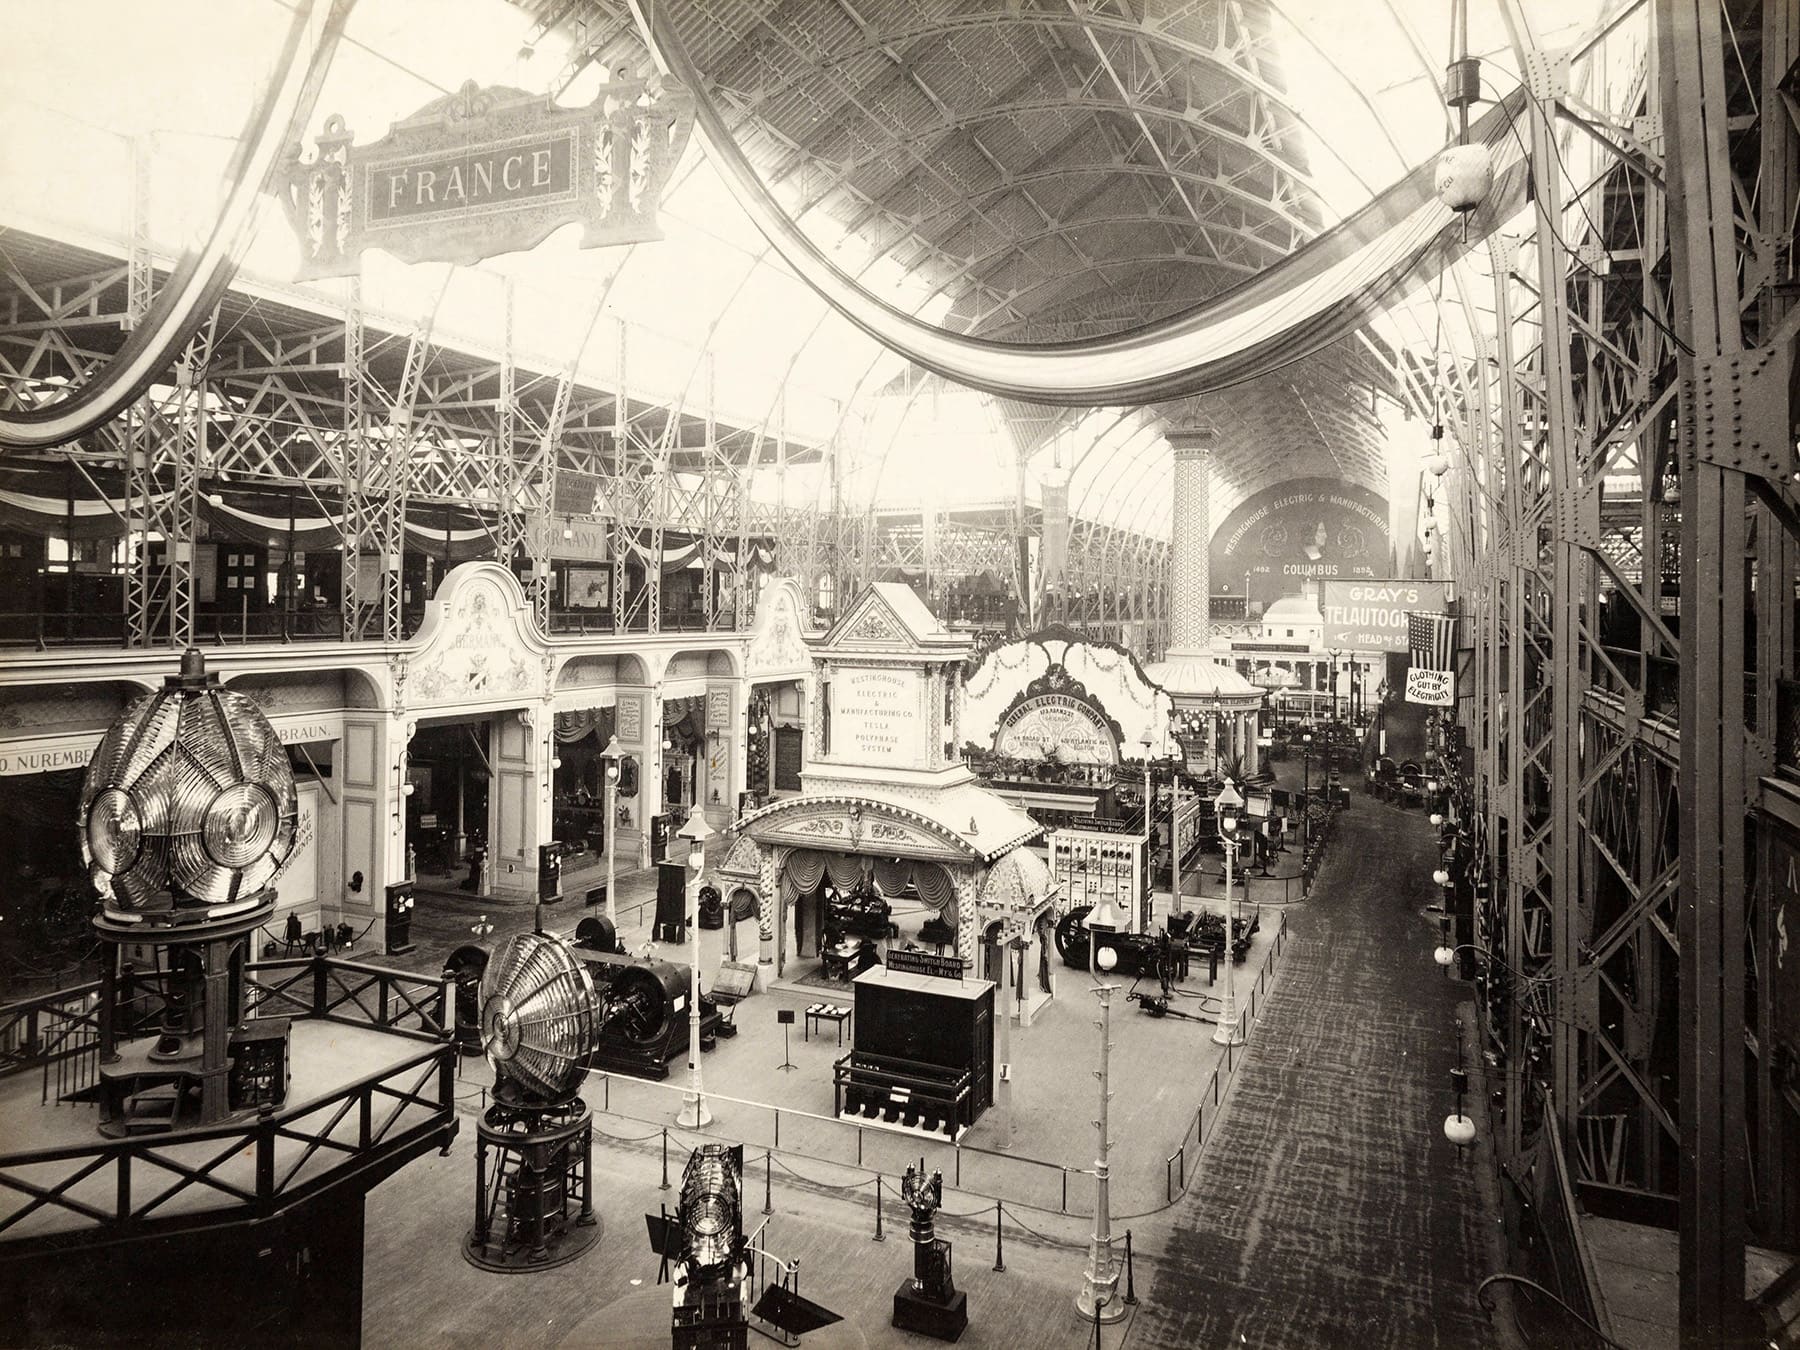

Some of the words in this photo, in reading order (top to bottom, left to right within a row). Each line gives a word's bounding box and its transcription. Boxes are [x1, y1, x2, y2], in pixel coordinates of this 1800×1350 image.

[389, 150, 552, 208] FRANCE
[1223, 506, 1269, 556] WESTINGHOUSE
[1274, 493, 1313, 510] ELECTRIC
[1318, 494, 1325, 503] &
[1283, 564, 1339, 576] COLUMBUS
[1349, 587, 1419, 603] GRAY'S
[1358, 632, 1382, 644] HEAD
[1409, 670, 1449, 685] CLOTHING
[1407, 685, 1449, 701] ELECTRICITY
[1432, 682, 1442, 691] BY
[857, 690, 897, 698] ELECTRIC
[841, 708, 901, 718] MANUFACTURING
[1006, 703, 1033, 728] GENERAL
[1035, 696, 1076, 708] ELECTRIC
[864, 721, 889, 730] TESLA
[279, 725, 331, 741] BRAUN.
[855, 734, 898, 743] POLYPHASE
[862, 744, 892, 753] SYSTEM
[17, 749, 96, 771] NUREMBE
[941, 957, 960, 969] BOARD
[999, 1065, 1008, 1079] J
